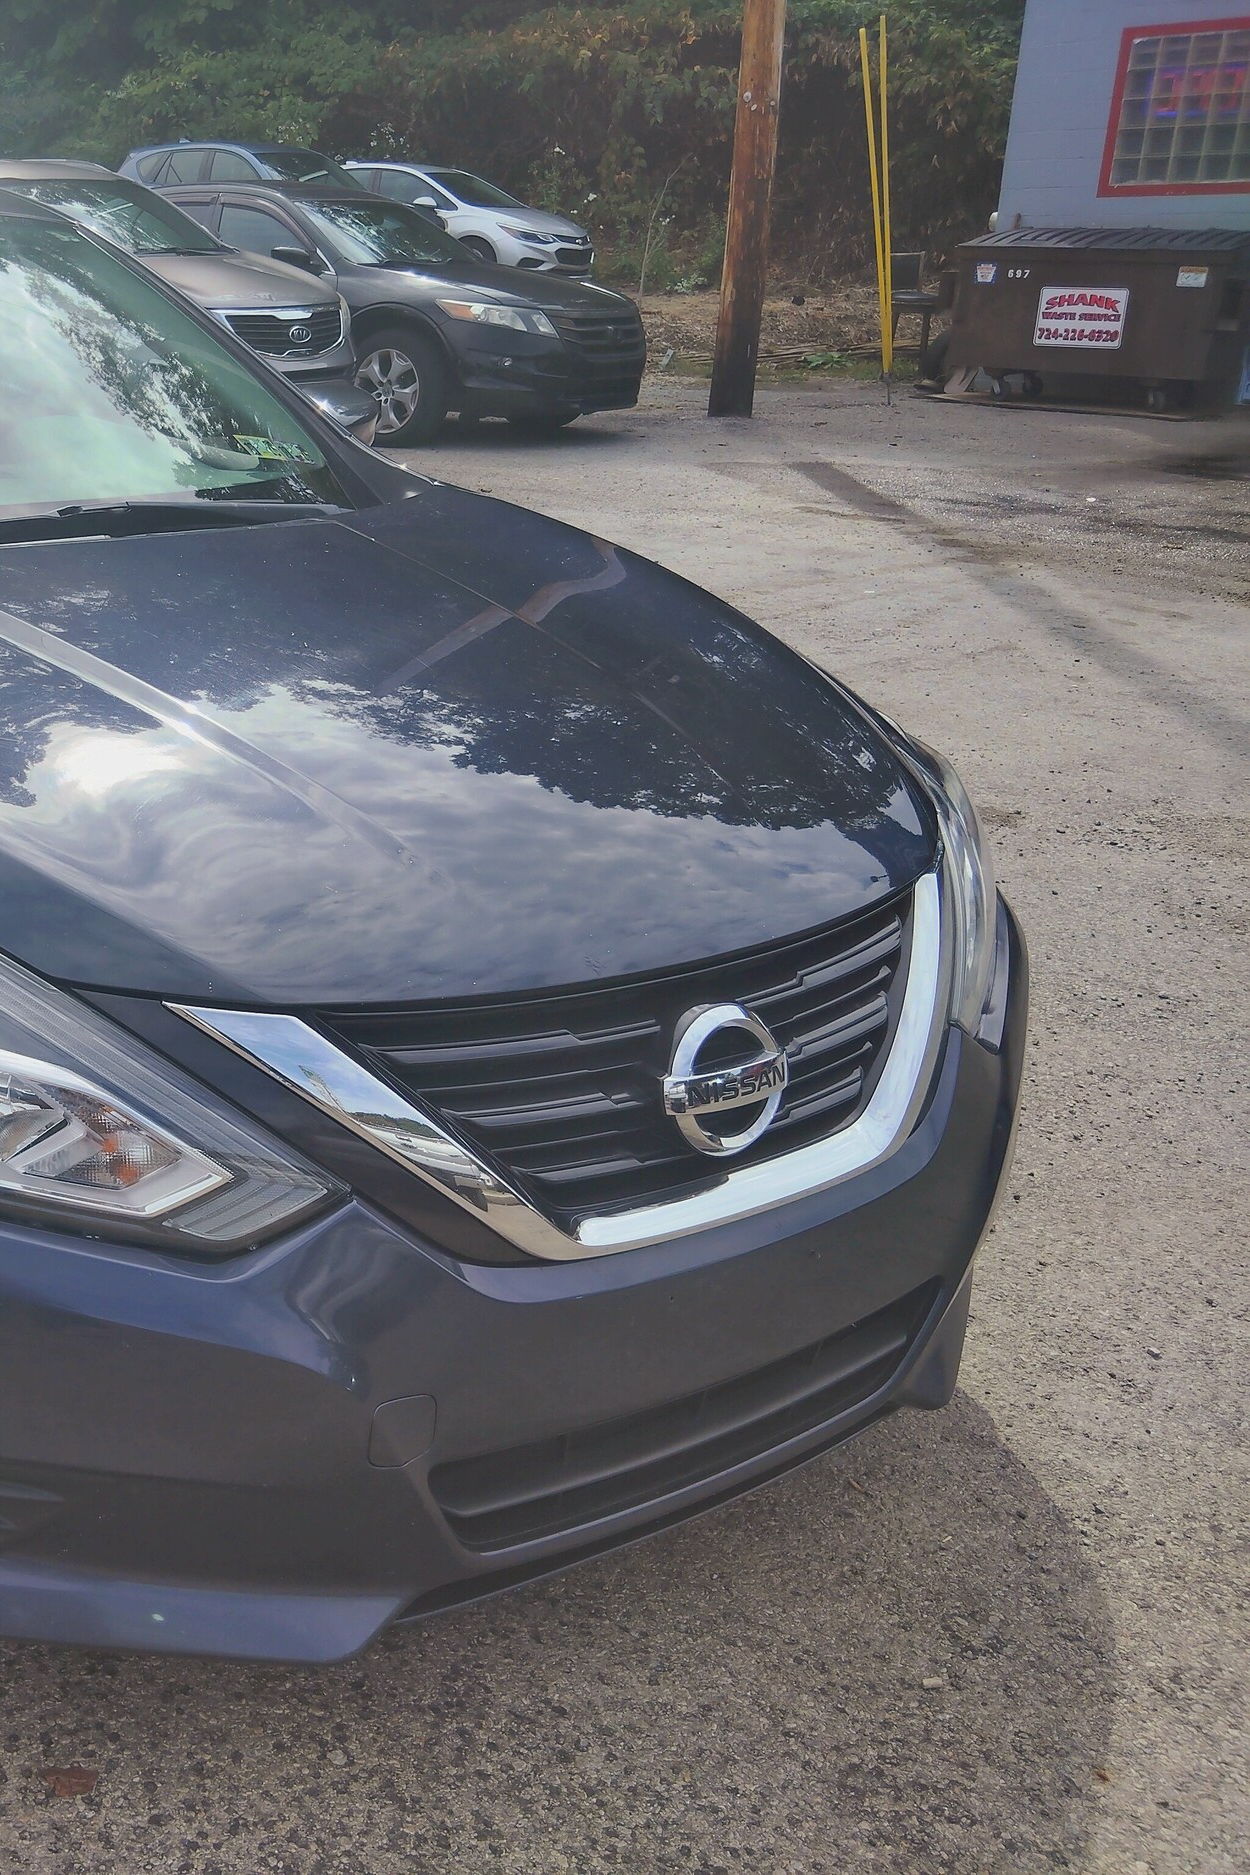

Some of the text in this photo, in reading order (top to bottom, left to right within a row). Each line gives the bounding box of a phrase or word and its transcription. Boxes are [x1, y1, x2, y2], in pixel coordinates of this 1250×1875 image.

[1007, 269, 1030, 279] 697
[1044, 293, 1121, 313] SHANK
[1041, 311, 1122, 323] WASTE SERVICE
[687, 1060, 786, 1107] NISSAN
